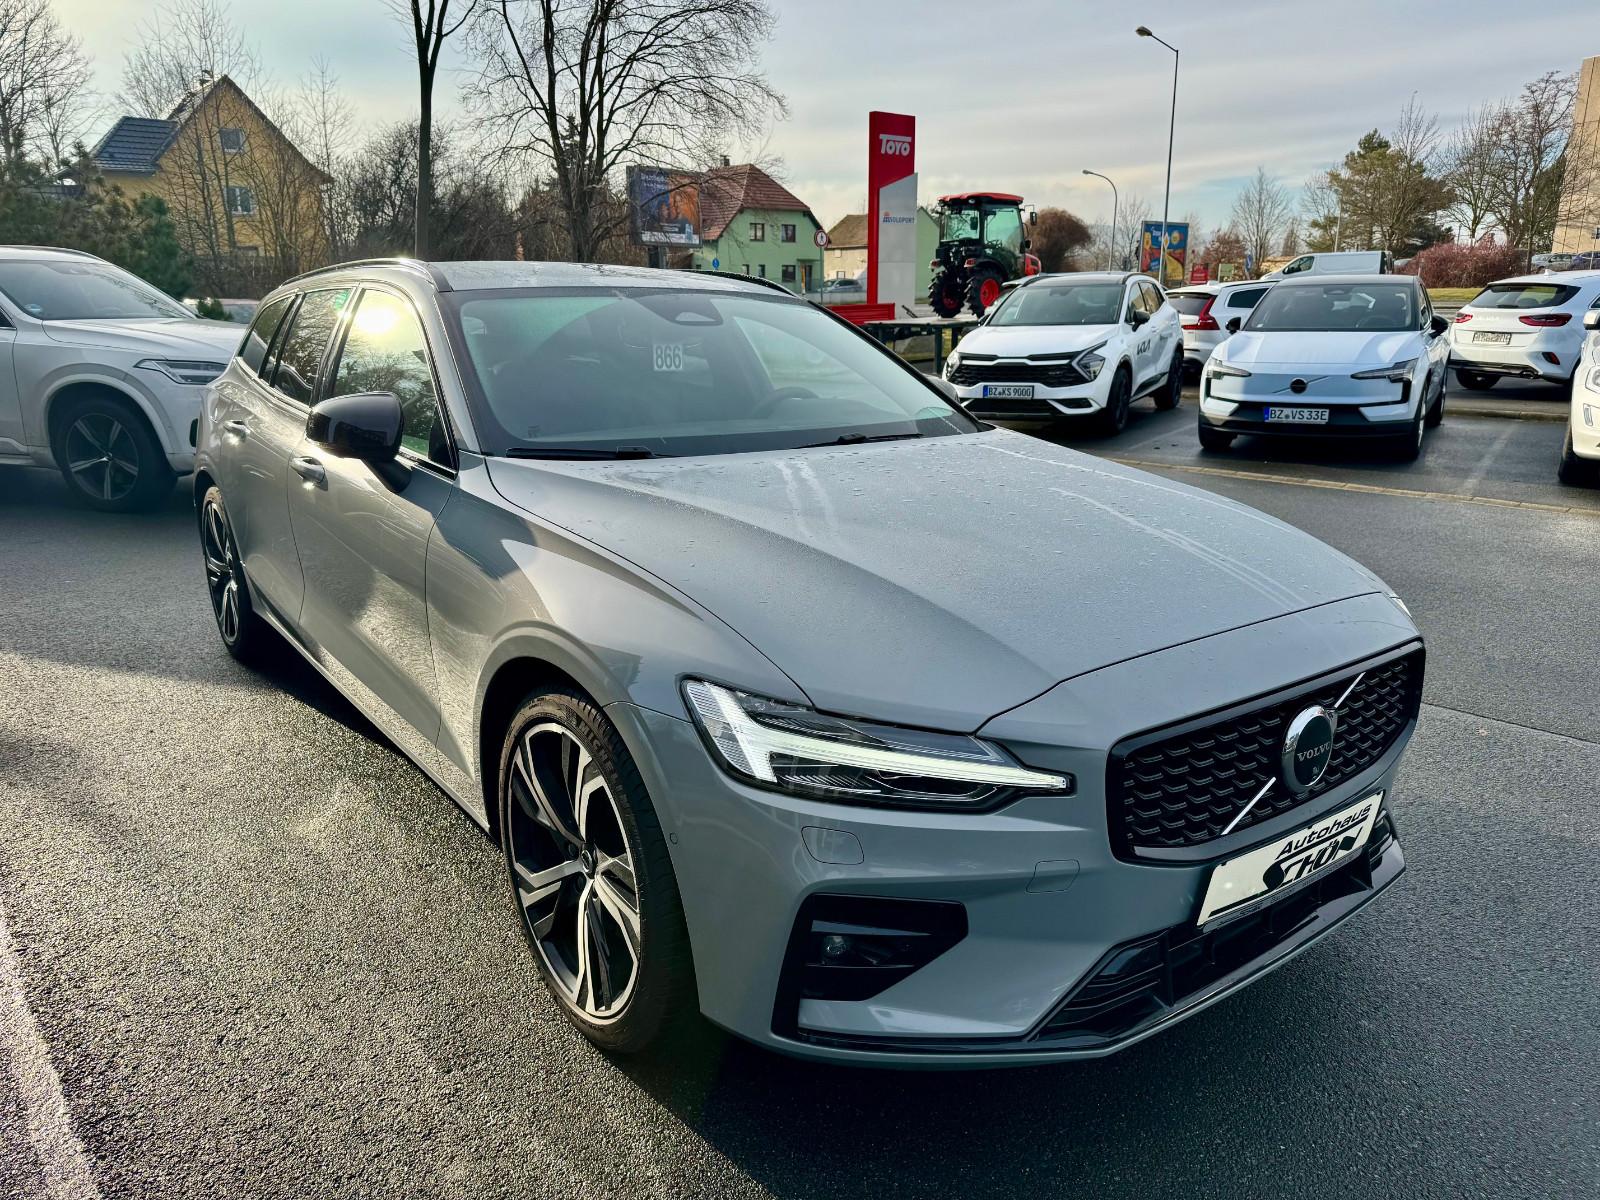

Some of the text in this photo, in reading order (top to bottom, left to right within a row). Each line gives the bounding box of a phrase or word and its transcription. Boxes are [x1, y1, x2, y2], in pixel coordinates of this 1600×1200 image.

[655, 345, 682, 369] 866
[988, 387, 998, 396] BZ
[1270, 409, 1284, 420] BZ
[1275, 803, 1373, 861] Autohaus
